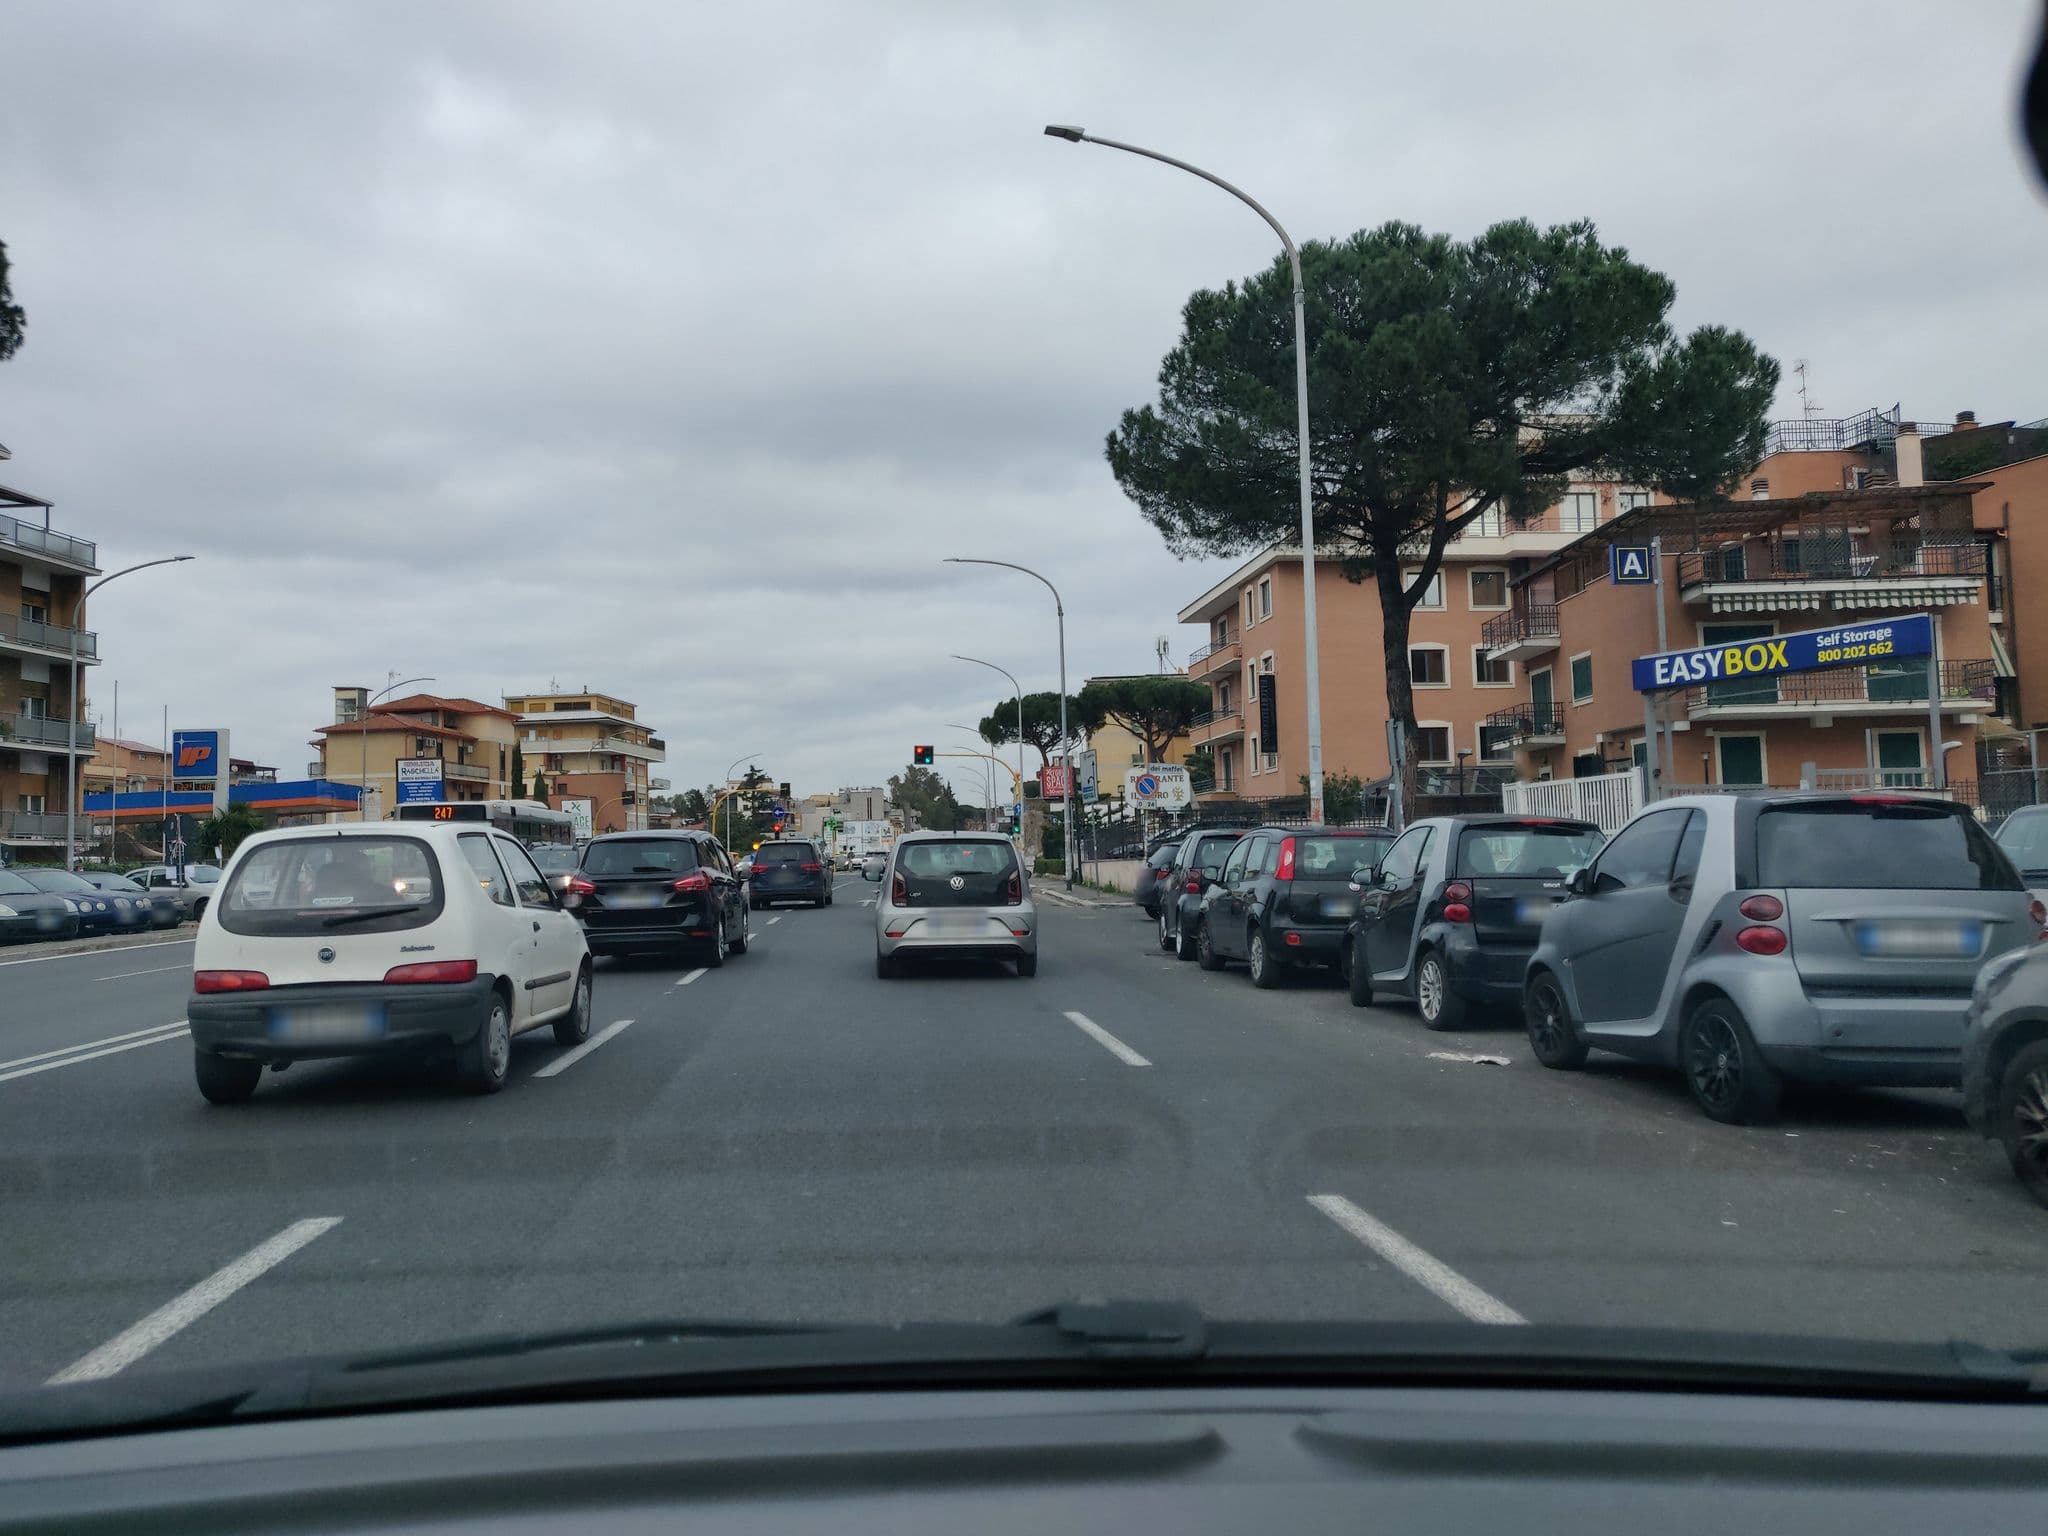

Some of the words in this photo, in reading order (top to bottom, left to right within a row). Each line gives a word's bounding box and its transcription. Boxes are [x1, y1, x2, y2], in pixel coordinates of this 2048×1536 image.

[1623, 552, 1643, 575] A
[1816, 632, 1841, 647] Self
[1842, 627, 1892, 644] Storage
[1818, 648, 1841, 662] 800
[1842, 645, 1867, 659] 202
[1868, 641, 1893, 656] 662
[1655, 640, 1789, 685] EASYBOX
[1130, 775, 1184, 783] RRANTE
[434, 807, 453, 819] 247
